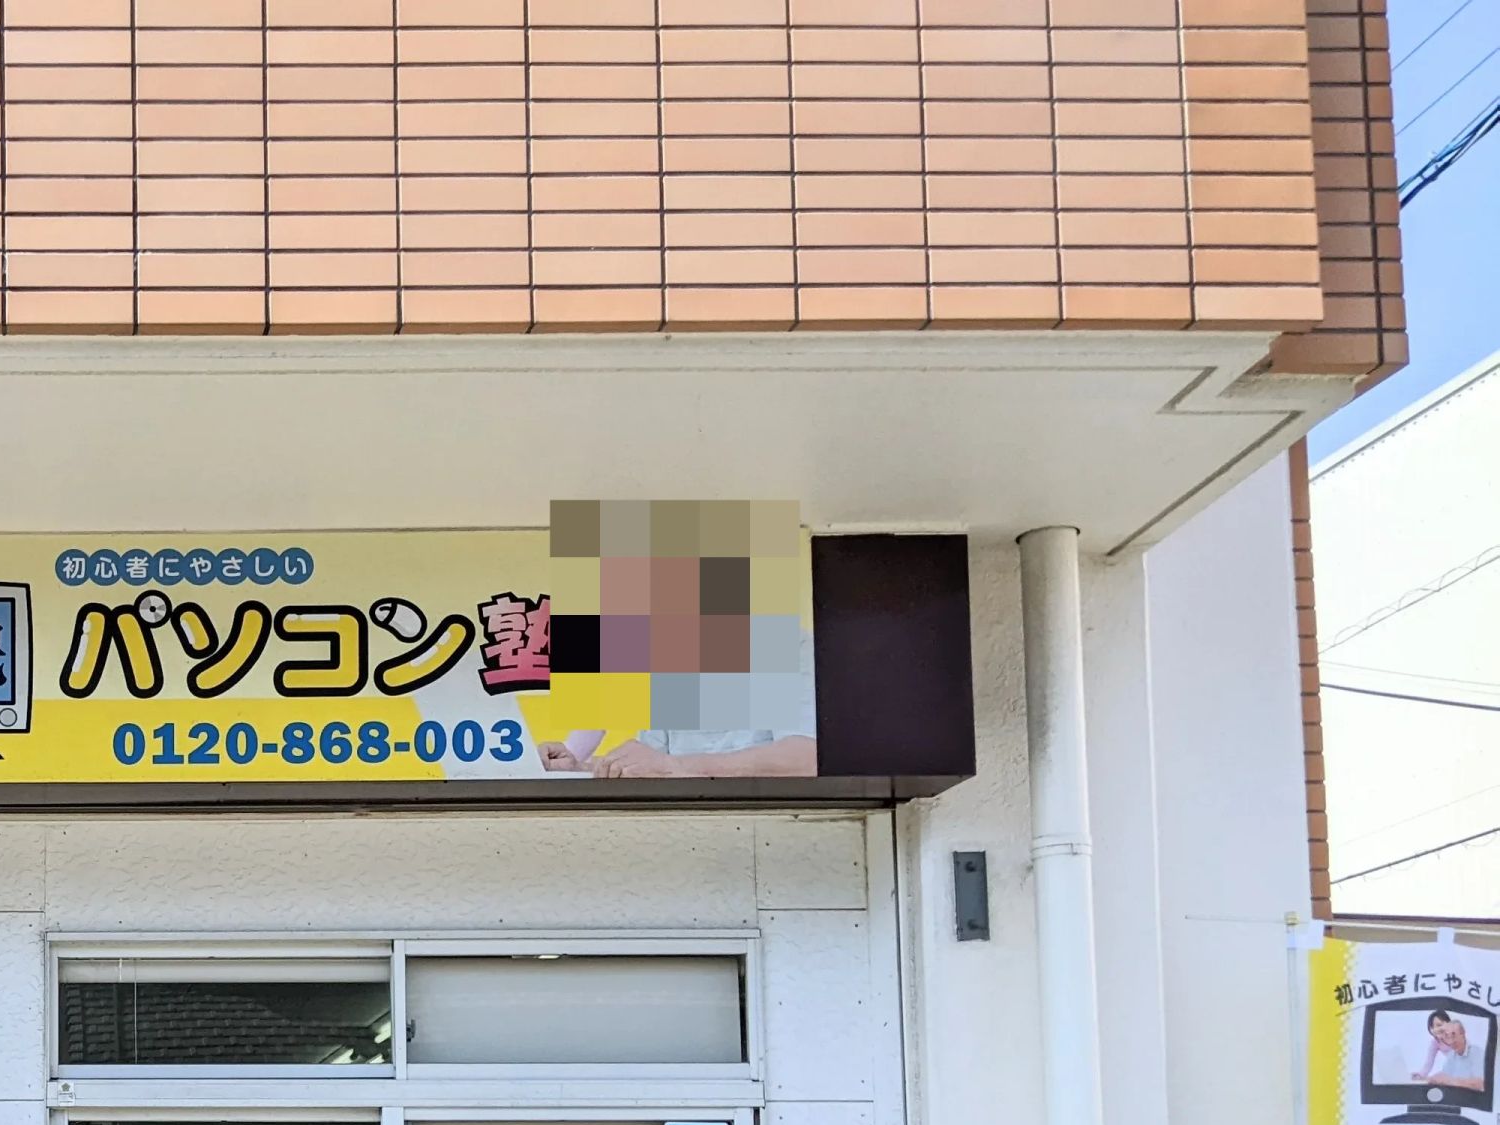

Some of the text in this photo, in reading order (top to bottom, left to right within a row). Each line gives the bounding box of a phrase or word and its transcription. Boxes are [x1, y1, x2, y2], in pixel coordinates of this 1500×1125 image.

[62, 555, 308, 580] 初心者にやさしい
[59, 589, 550, 698] パソコン塾
[112, 720, 524, 765] 0120-868-003
